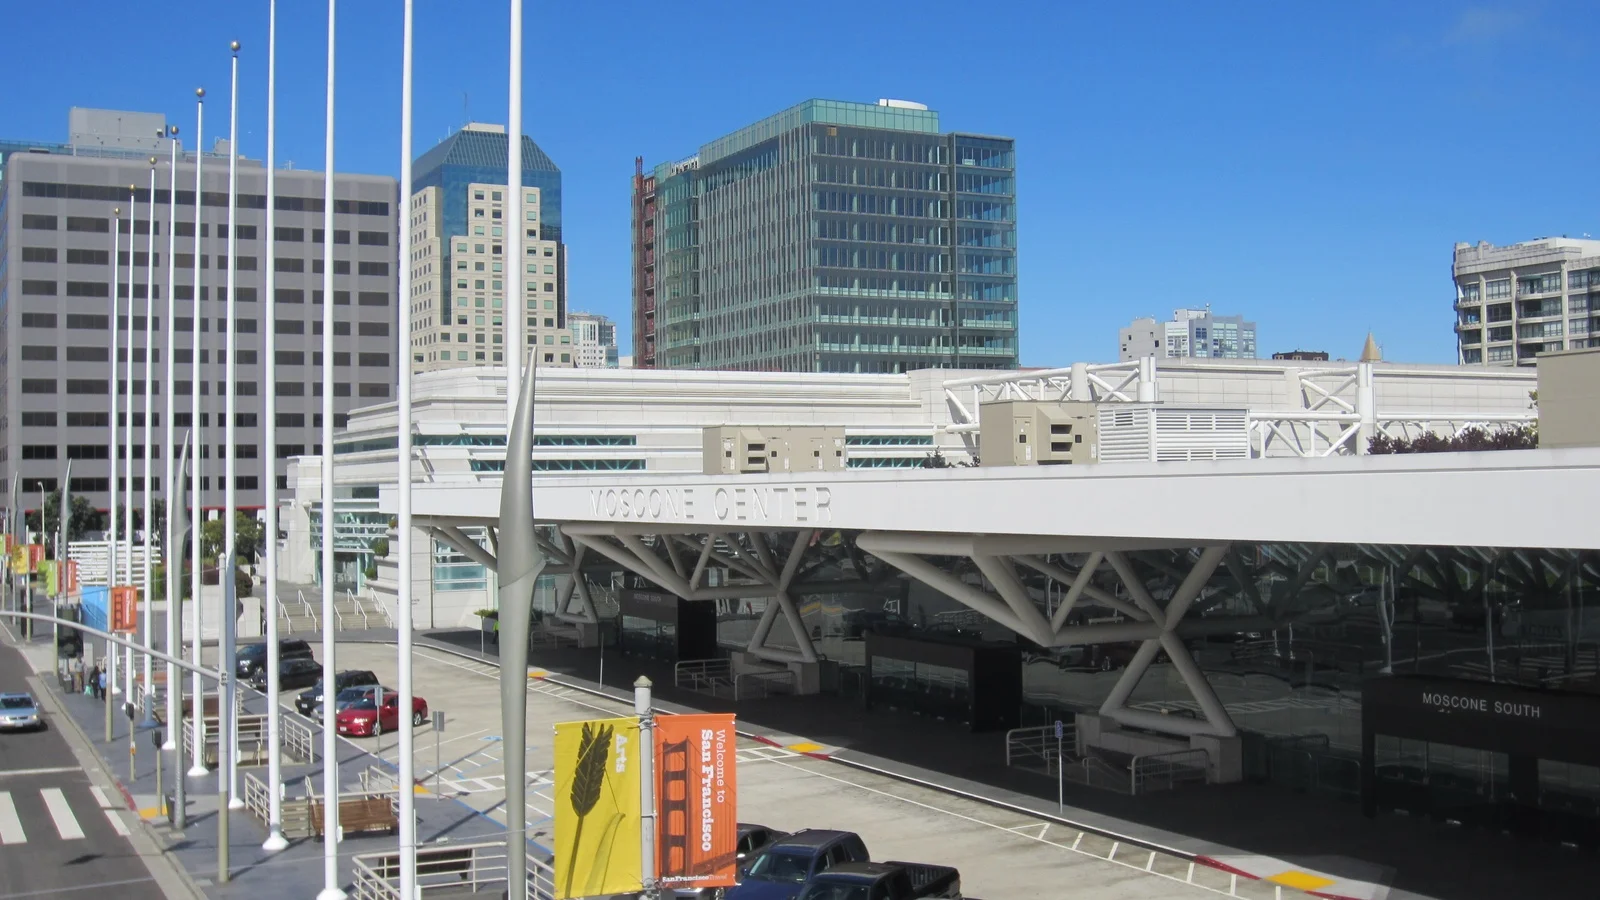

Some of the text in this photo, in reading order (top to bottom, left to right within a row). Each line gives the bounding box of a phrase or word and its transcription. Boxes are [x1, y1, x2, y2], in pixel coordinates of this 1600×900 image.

[589, 487, 833, 522] MOSCONE CENTER
[1422, 692, 1541, 718] MOSCONE SOUTH
[616, 734, 628, 773] Arts
[716, 729, 725, 803] Welcome to
[701, 729, 713, 851] San Francisco
